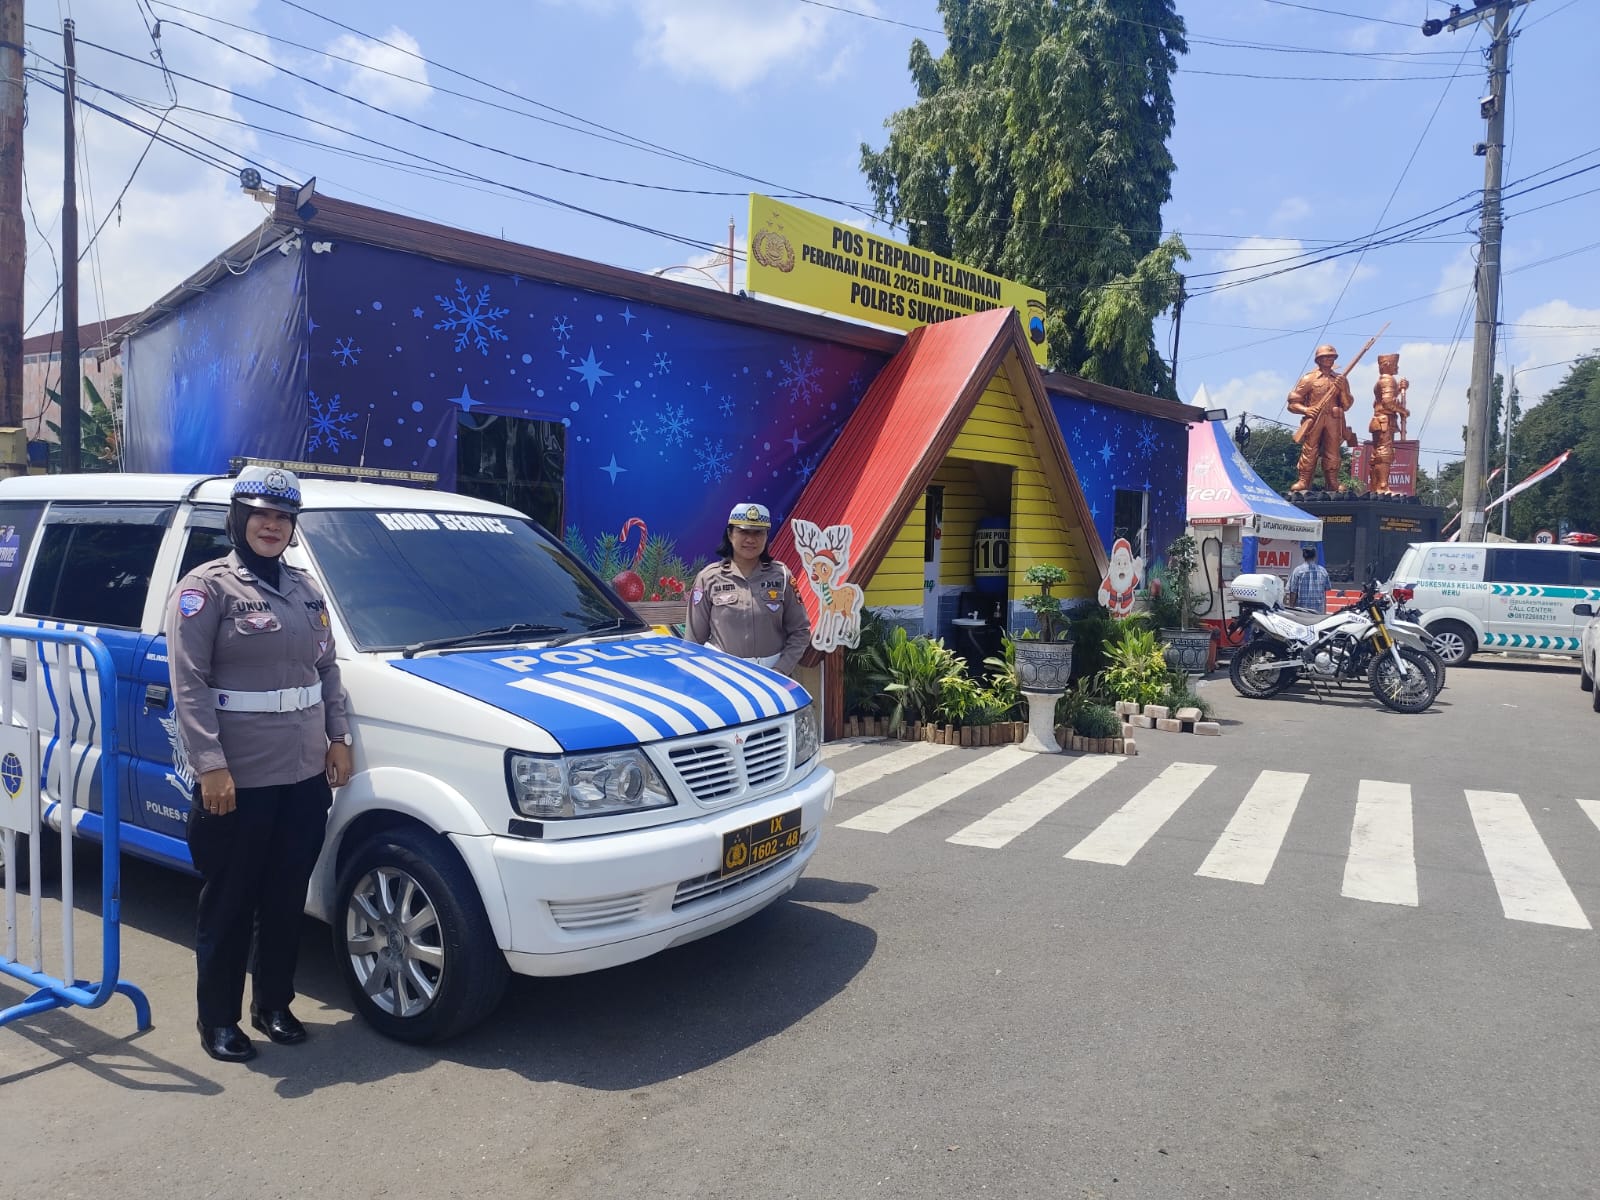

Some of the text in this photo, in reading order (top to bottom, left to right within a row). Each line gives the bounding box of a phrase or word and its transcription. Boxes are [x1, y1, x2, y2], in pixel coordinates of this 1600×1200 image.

[832, 226, 1001, 300] POS TERPADU PELAYANAN
[802, 244, 859, 276] PERAYAAN
[861, 263, 891, 286] NATAL
[893, 273, 919, 294] 2025
[922, 281, 940, 301] DAN
[943, 288, 972, 310] TAHUN
[851, 282, 904, 316] POLRES
[375, 513, 514, 534] ROAD SERVICE
[1538, 535, 1547, 544] 30
[975, 540, 1009, 569] 110
[1257, 551, 1291, 566] TAN
[1417, 581, 1455, 589] PUSKESMAS
[1442, 589, 1461, 597] WERU
[491, 643, 697, 673] POLISI
[146, 801, 189, 822] POLRES S
[770, 816, 783, 834] IX
[752, 839, 778, 862] 1602
[786, 831, 799, 847] 48
